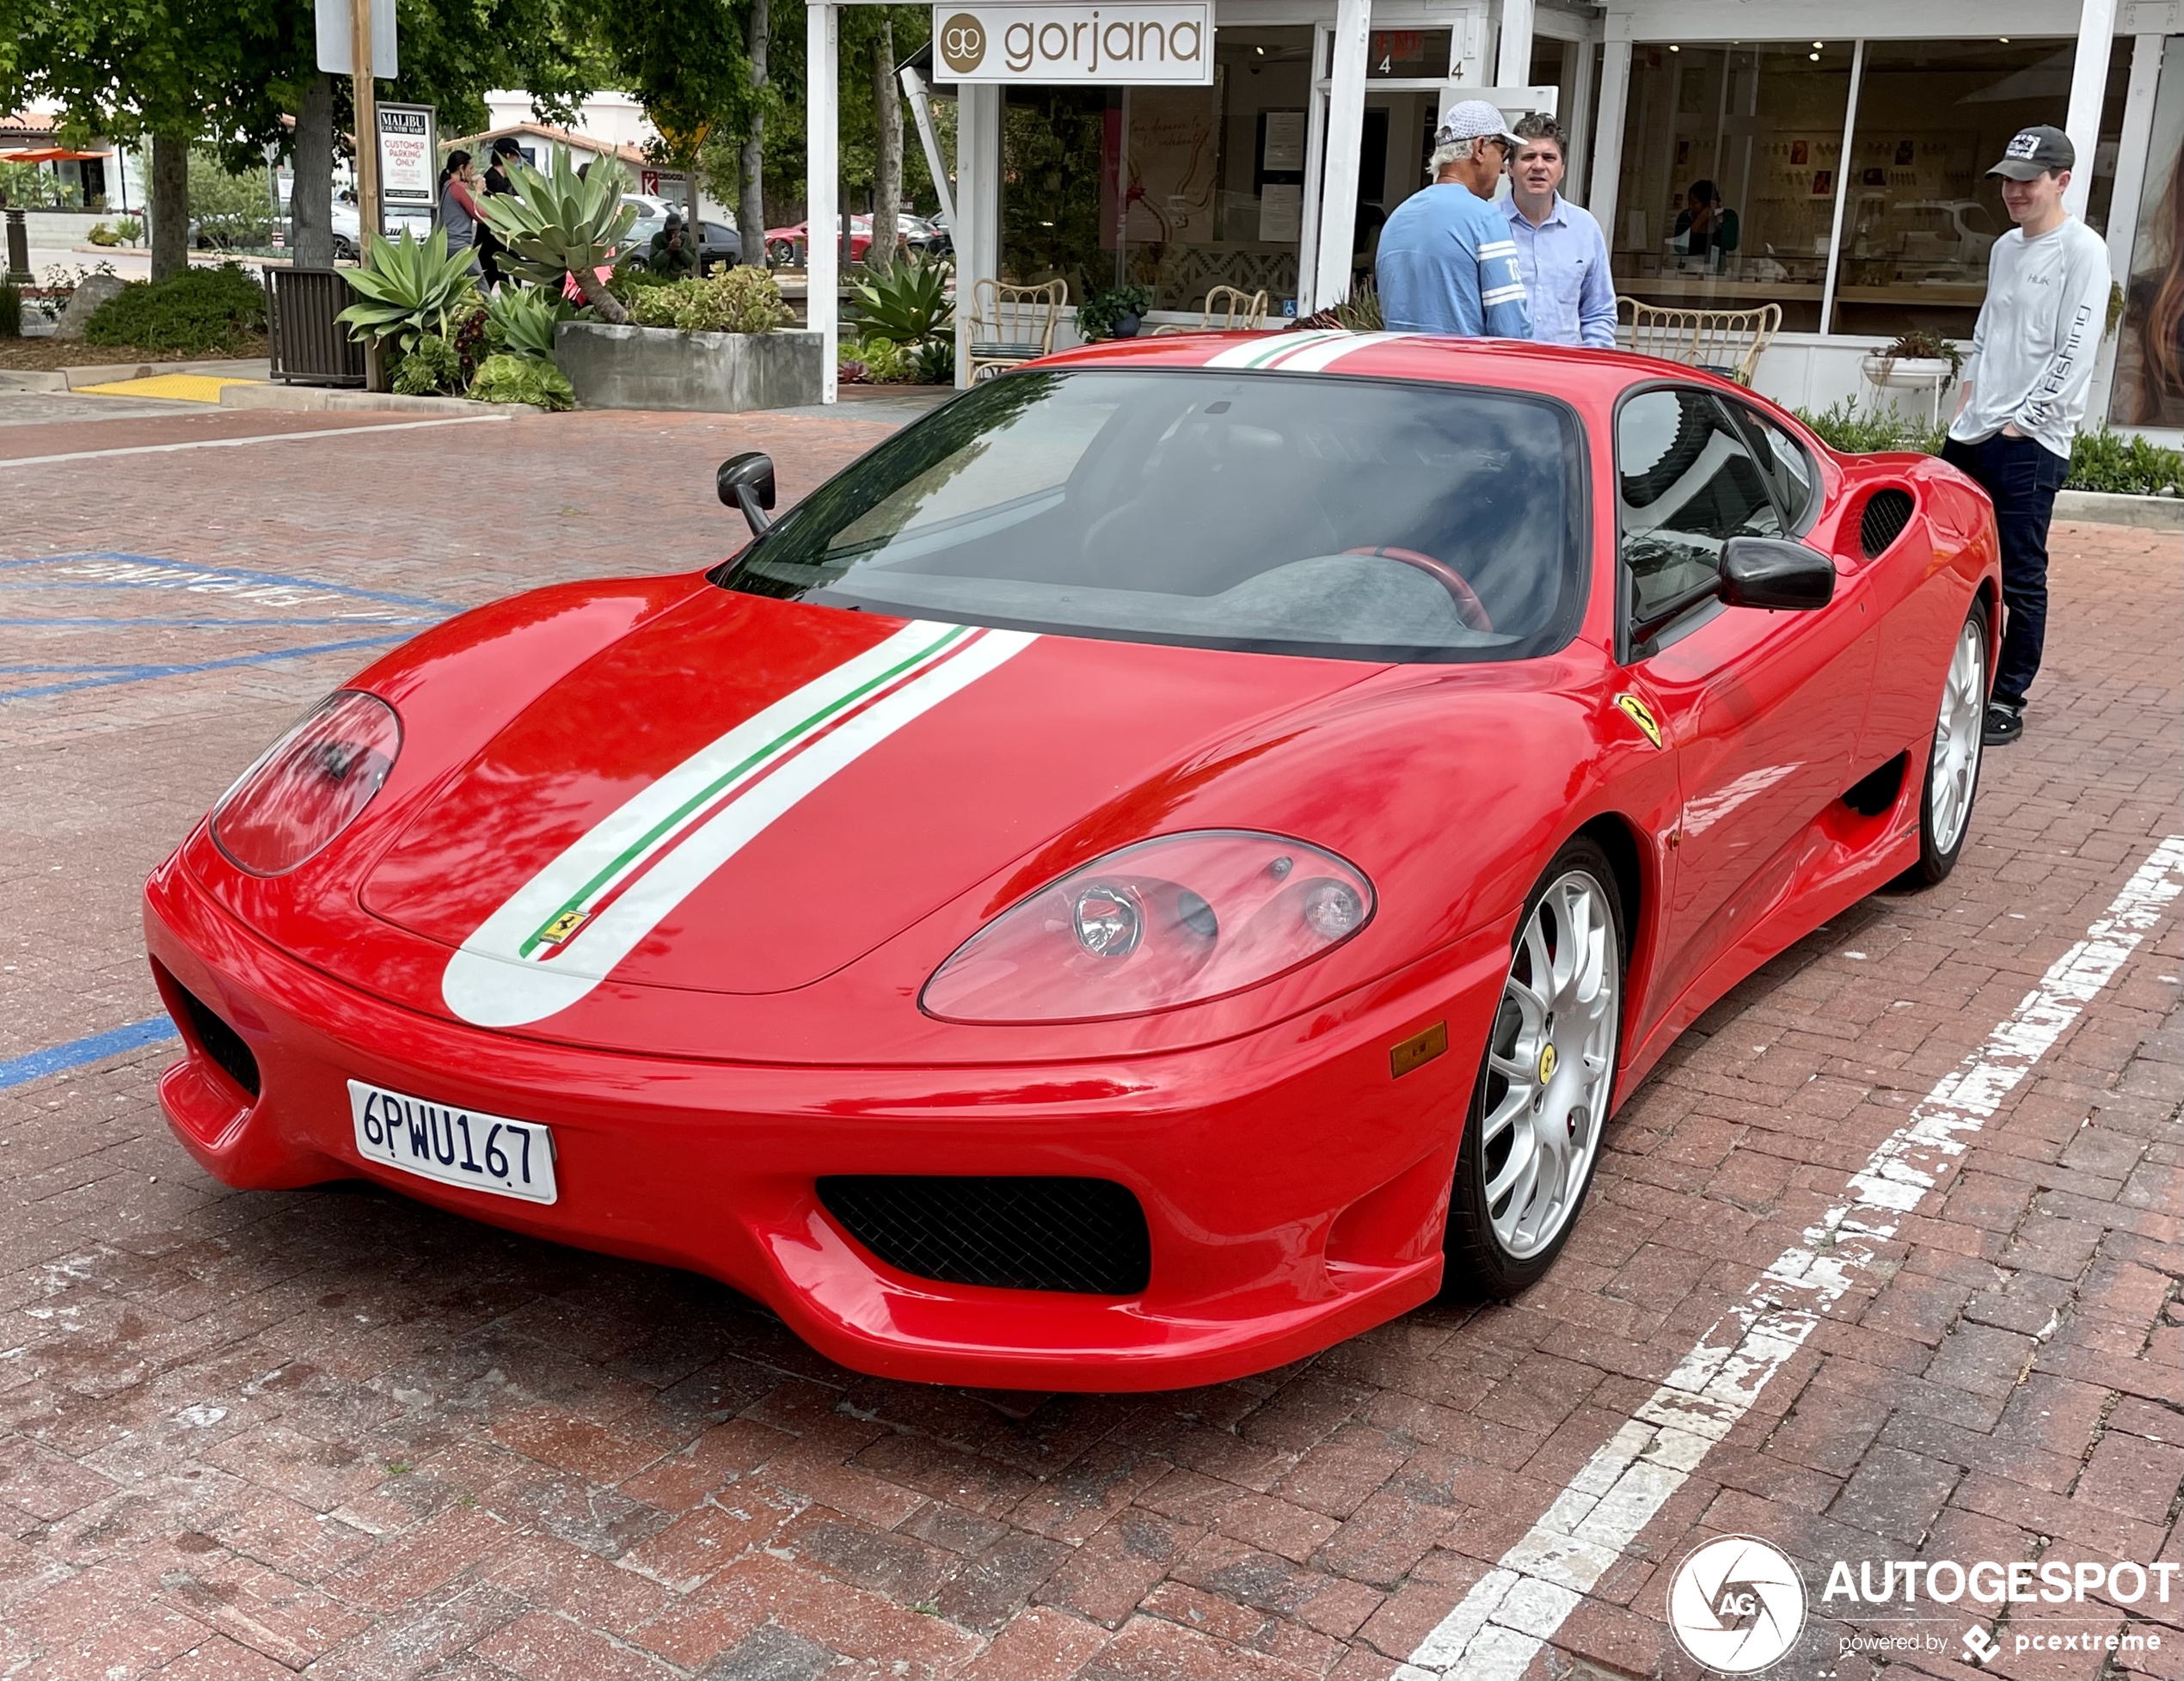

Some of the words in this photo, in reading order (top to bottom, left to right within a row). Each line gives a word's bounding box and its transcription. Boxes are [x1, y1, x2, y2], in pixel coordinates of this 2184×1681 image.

[1004, 10, 1201, 73] gorjana
[1378, 54, 1391, 74] 4
[1451, 60, 1464, 81] 4
[382, 113, 424, 127] MALIBU
[382, 125, 408, 133] COUNTRY
[384, 140, 425, 150] CUSTOMER
[389, 149, 421, 158] PARKING
[2044, 304, 2092, 394] Fishing
[364, 1091, 531, 1184] 6PWU167
